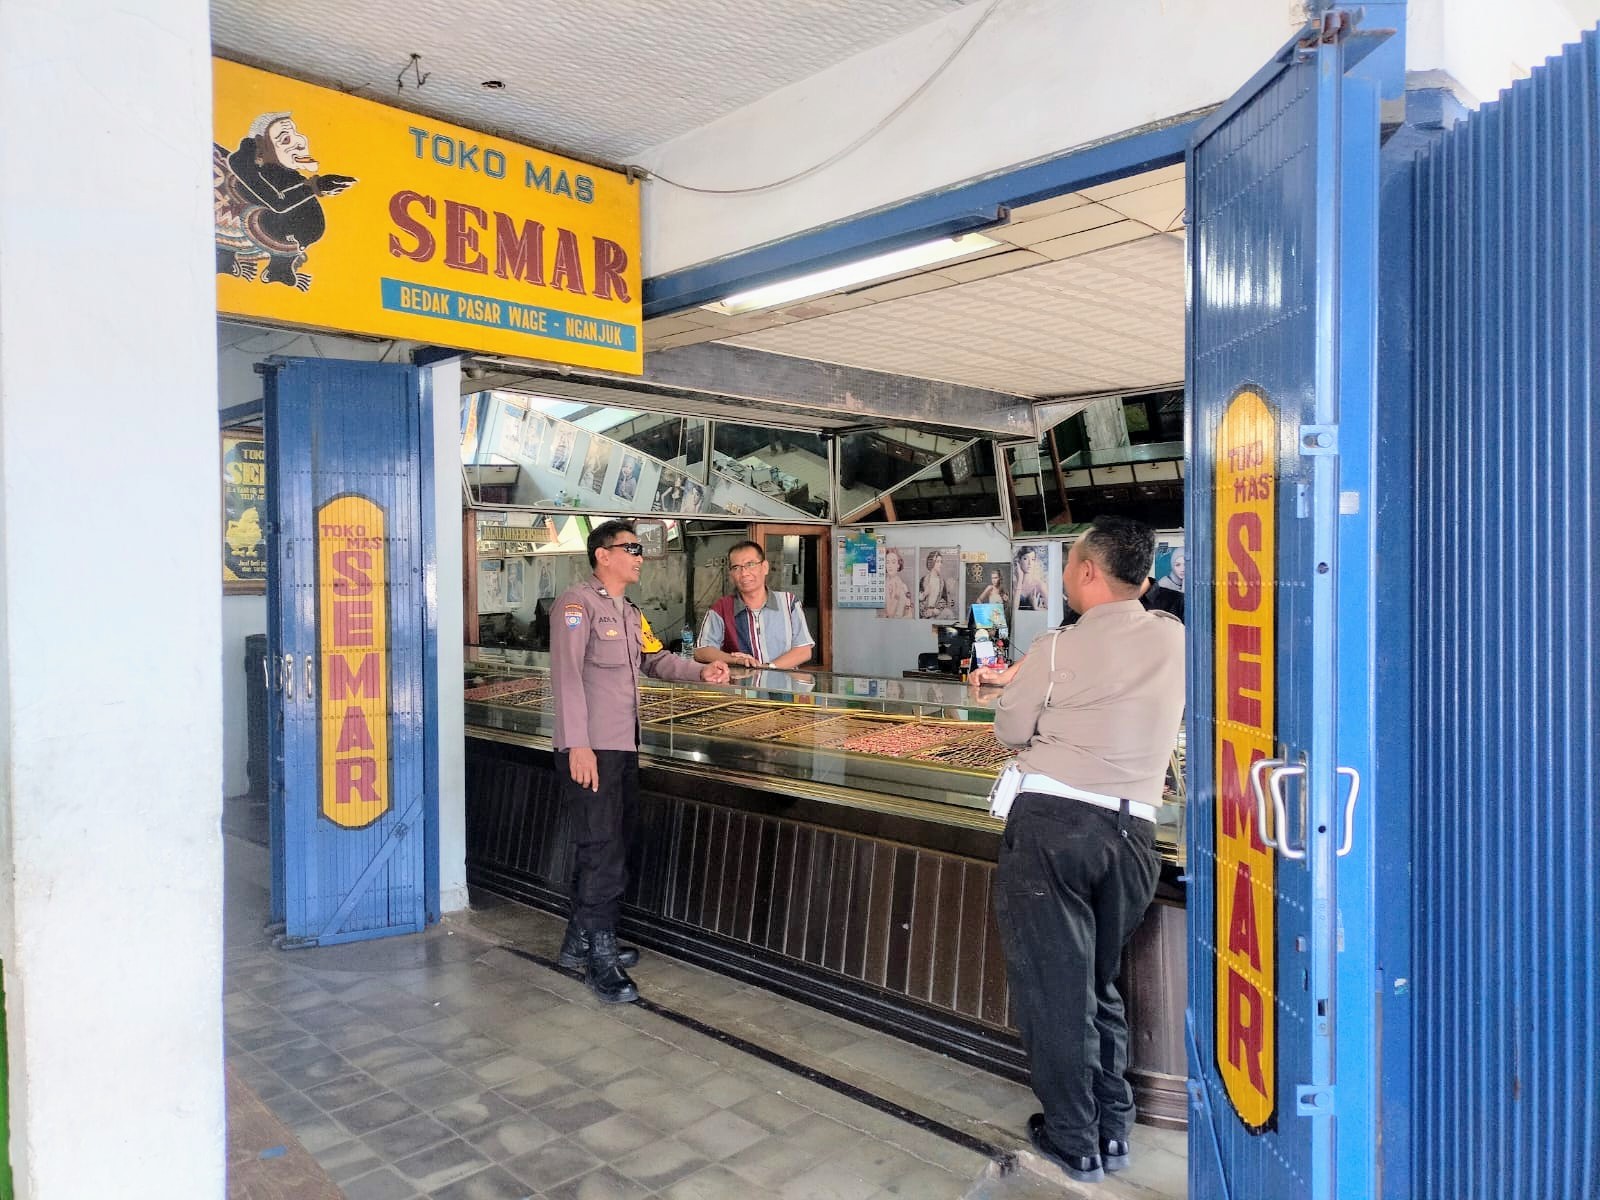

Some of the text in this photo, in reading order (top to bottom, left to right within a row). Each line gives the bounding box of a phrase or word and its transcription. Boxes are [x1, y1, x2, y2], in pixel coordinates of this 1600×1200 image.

[408, 126, 596, 204] TOKO MAS
[388, 189, 632, 303] SEMAR
[400, 286, 450, 315] BEDAK
[457, 296, 502, 325] PASAR
[508, 305, 548, 333] WAGE
[565, 317, 623, 346] NGANJUK
[1234, 472, 1273, 504] MAS
[320, 524, 367, 538] TOKO
[345, 536, 383, 550] MAS
[327, 550, 382, 804] SEMAR
[1221, 511, 1268, 1100] SEMAR
